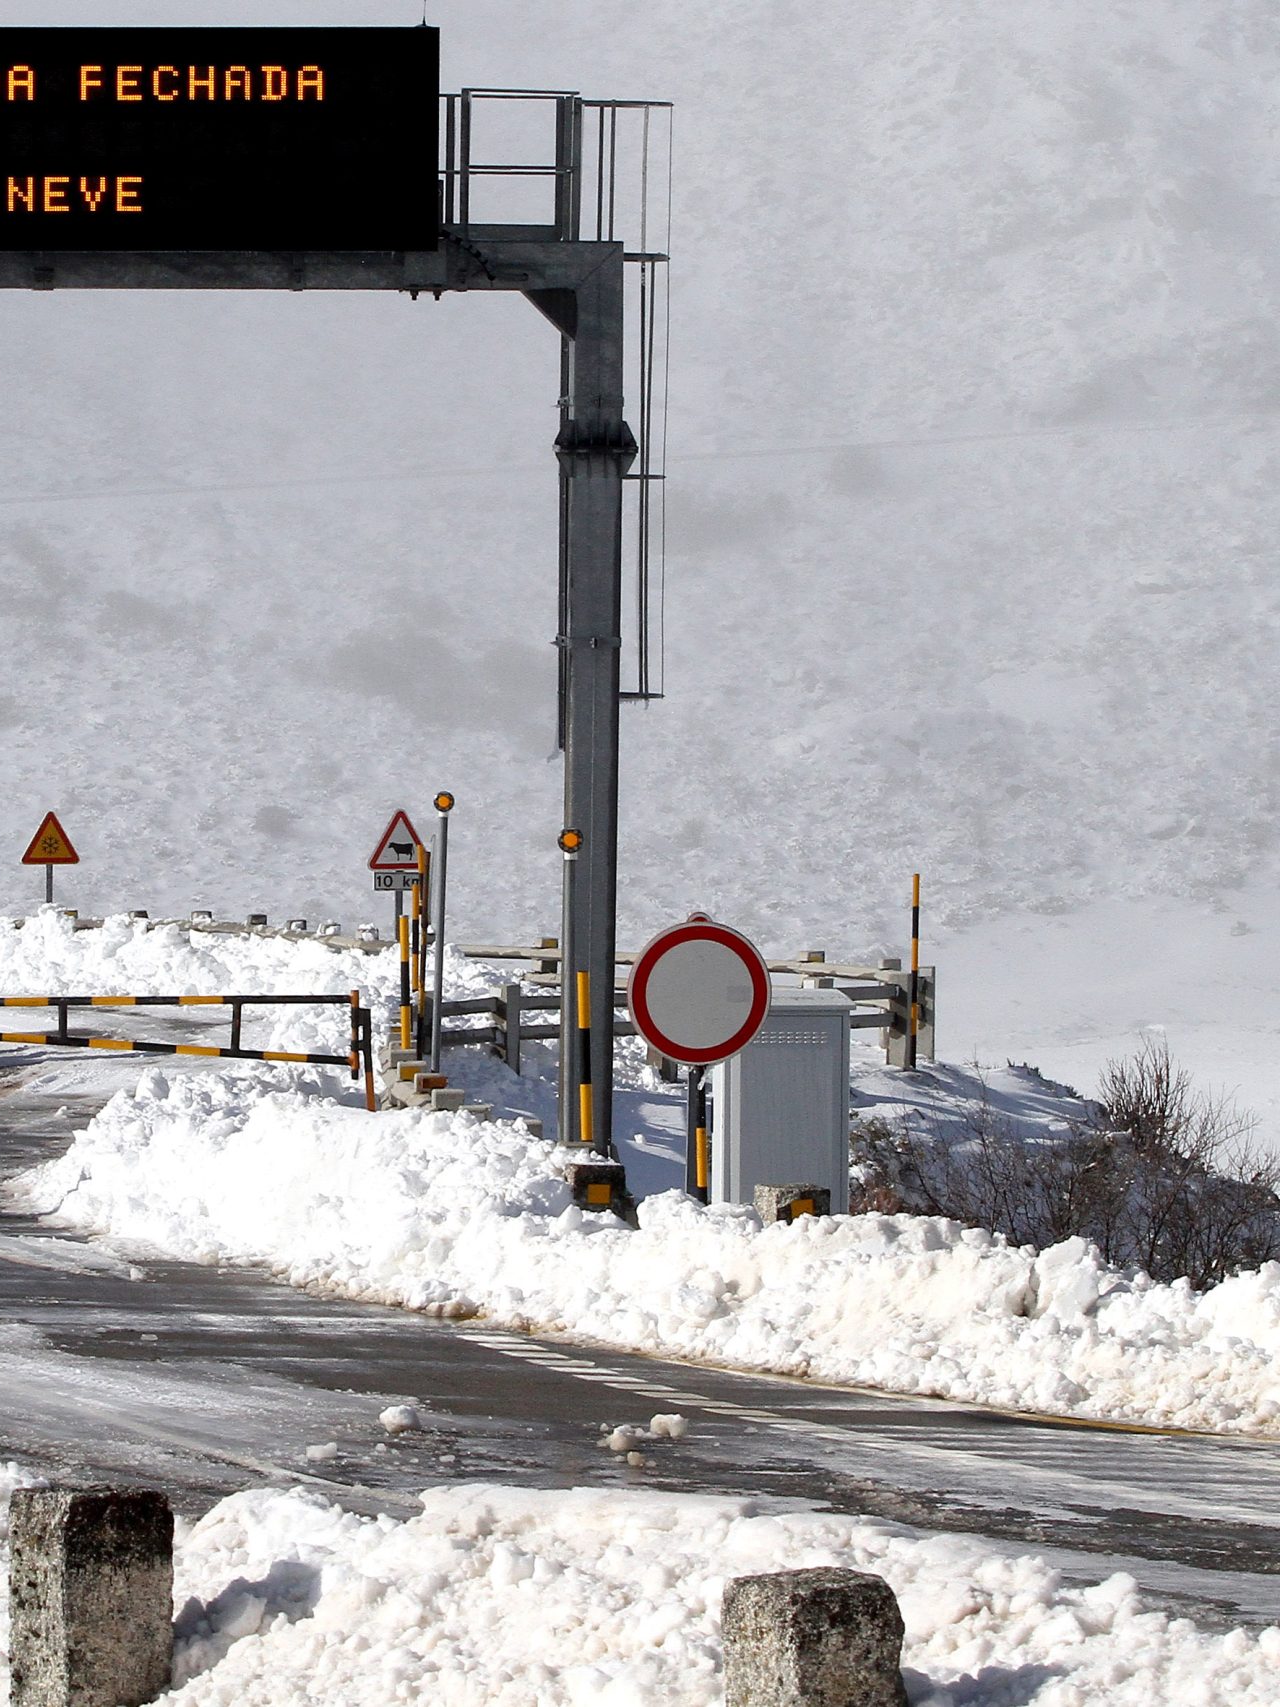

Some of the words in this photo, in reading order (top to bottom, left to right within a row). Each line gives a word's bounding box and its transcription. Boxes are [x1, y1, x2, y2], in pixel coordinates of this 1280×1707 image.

[79, 64, 324, 101] FECHADA
[7, 176, 143, 212] NEVE
[376, 875, 393, 888] 10
